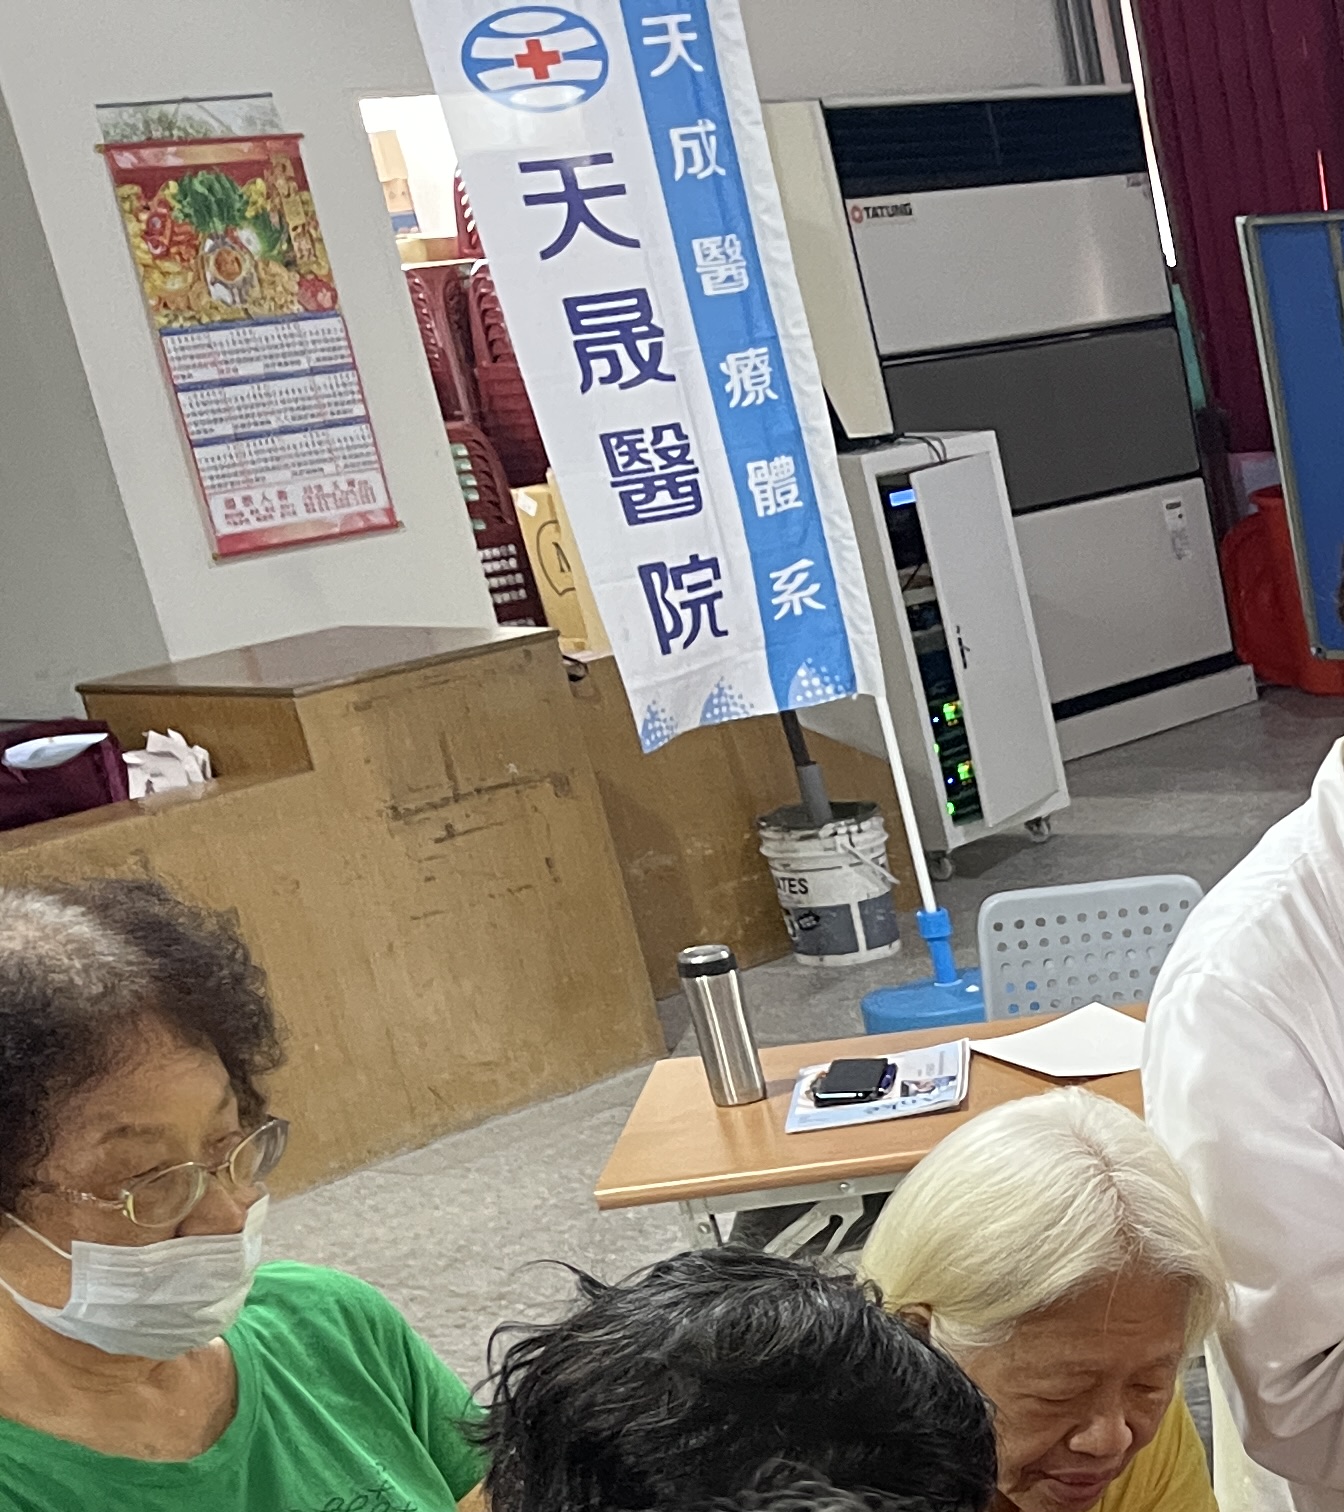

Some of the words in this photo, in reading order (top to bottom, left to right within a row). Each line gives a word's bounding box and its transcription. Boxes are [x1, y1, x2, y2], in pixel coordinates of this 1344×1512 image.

[517, 151, 729, 656] 天晟醫院
[640, 13, 827, 623] 天成醫療體系
